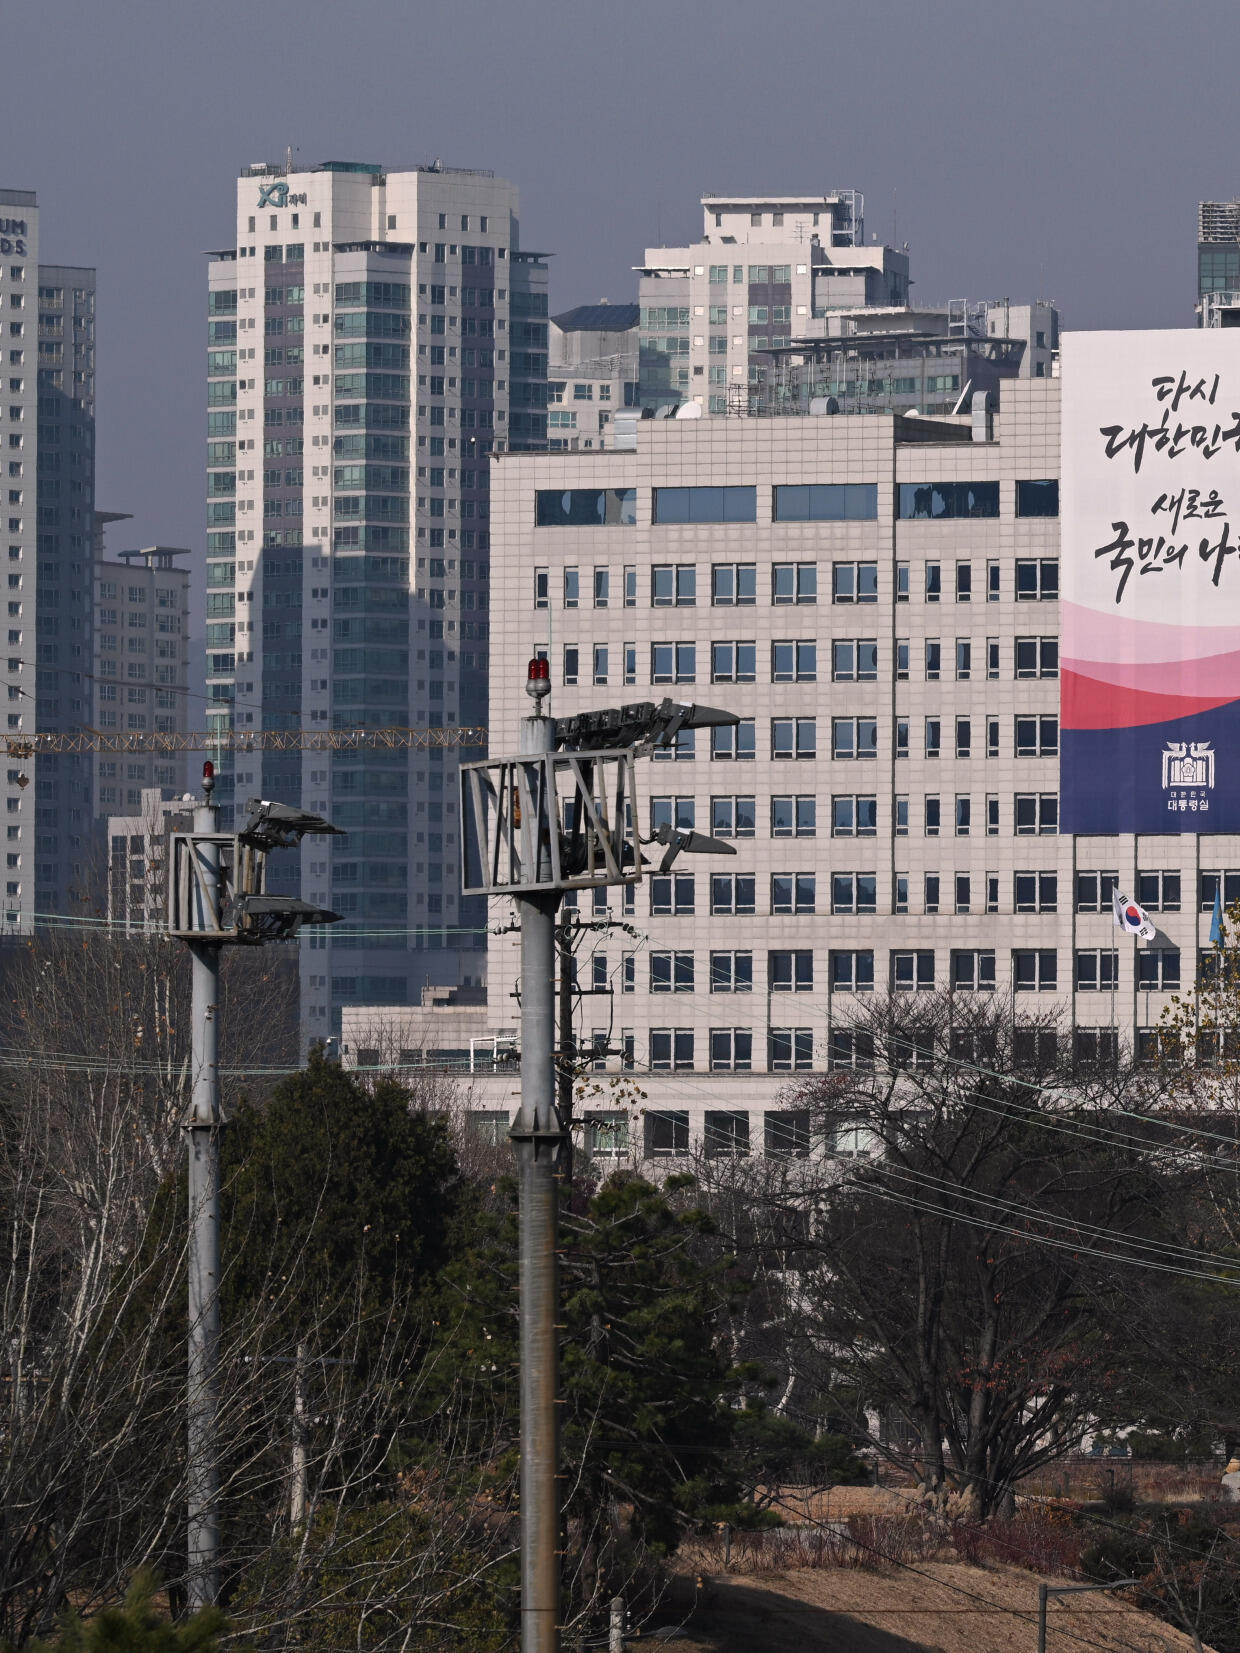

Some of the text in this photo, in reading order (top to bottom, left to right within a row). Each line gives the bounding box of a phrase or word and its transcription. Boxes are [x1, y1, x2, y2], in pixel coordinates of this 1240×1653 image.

[1152, 370, 1220, 412] 다시
[1151, 488, 1228, 536] 새로운
[1094, 521, 1189, 604] 국민의
[1167, 799, 1209, 811] 대통령실
